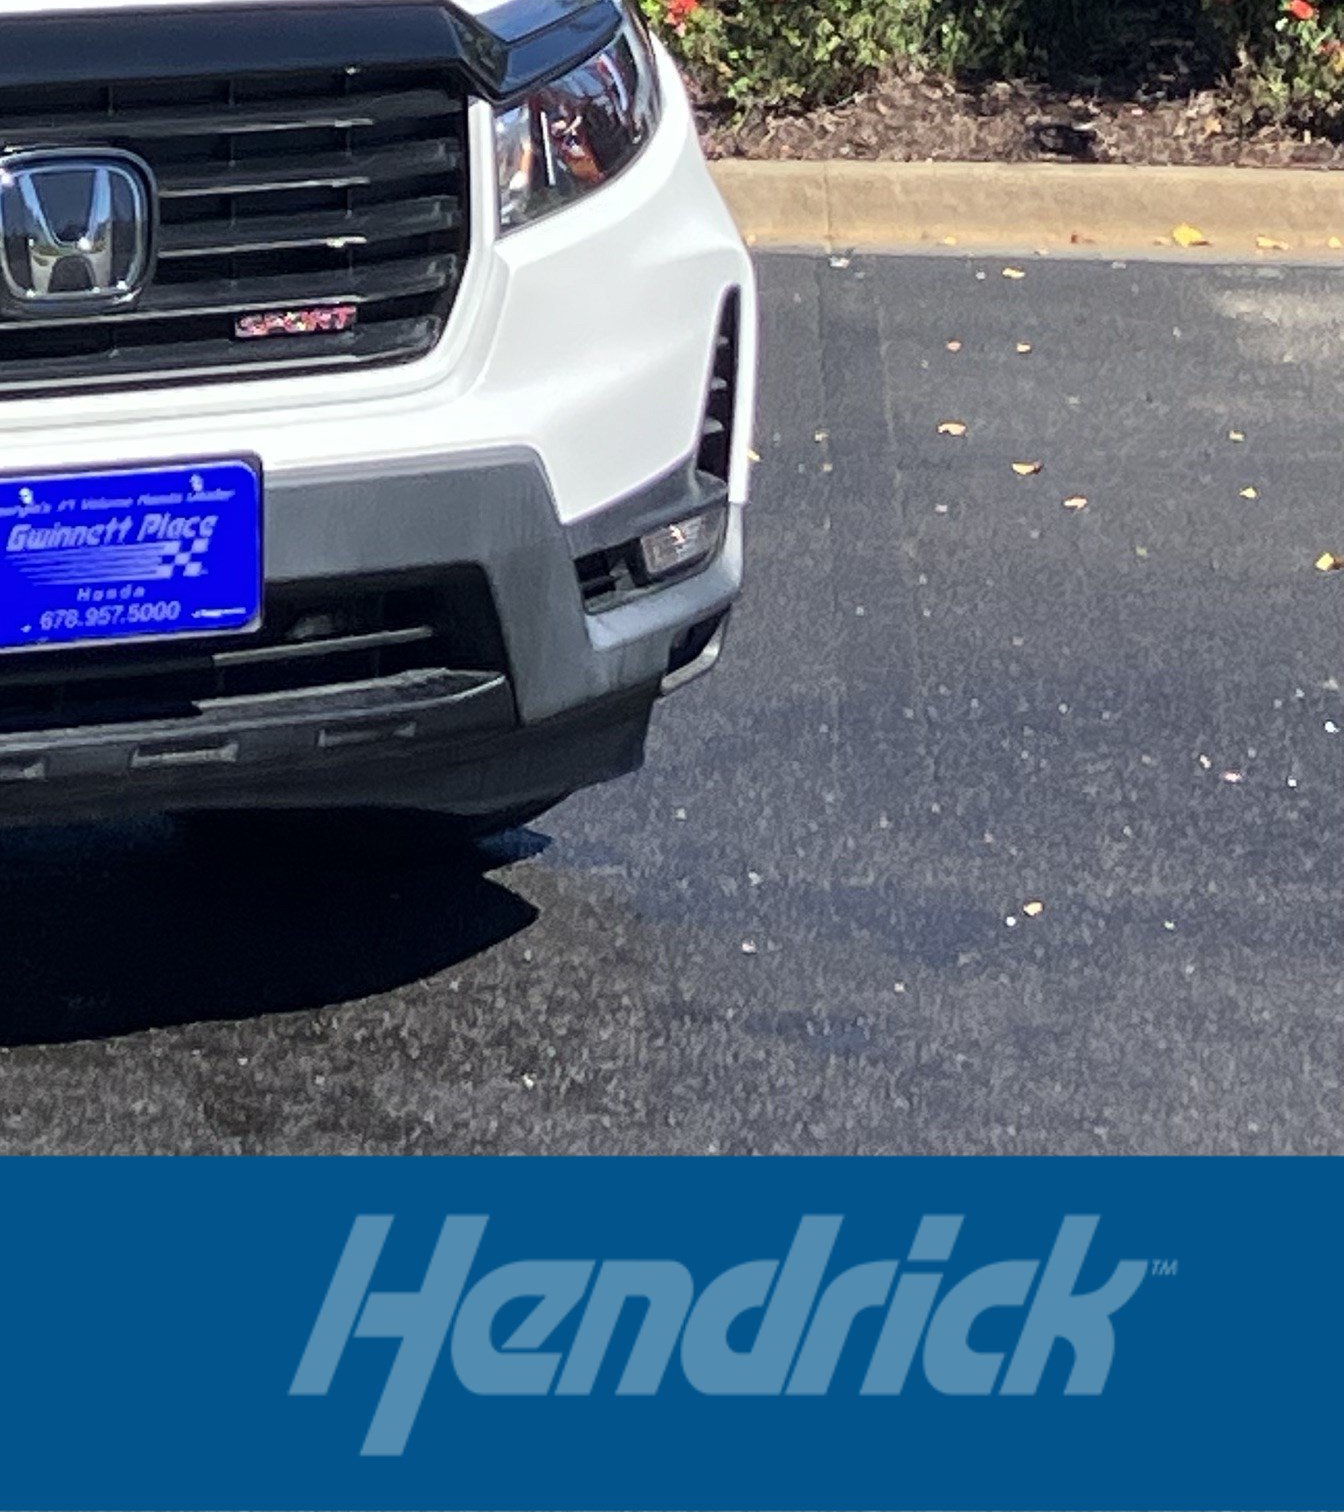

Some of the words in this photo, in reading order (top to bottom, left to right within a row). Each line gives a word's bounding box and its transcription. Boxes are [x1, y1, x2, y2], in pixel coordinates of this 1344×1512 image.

[5, 514, 134, 552] Gwinnett
[136, 511, 219, 542] Place
[76, 584, 146, 602] Honda
[39, 600, 182, 631] 678.957.5000
